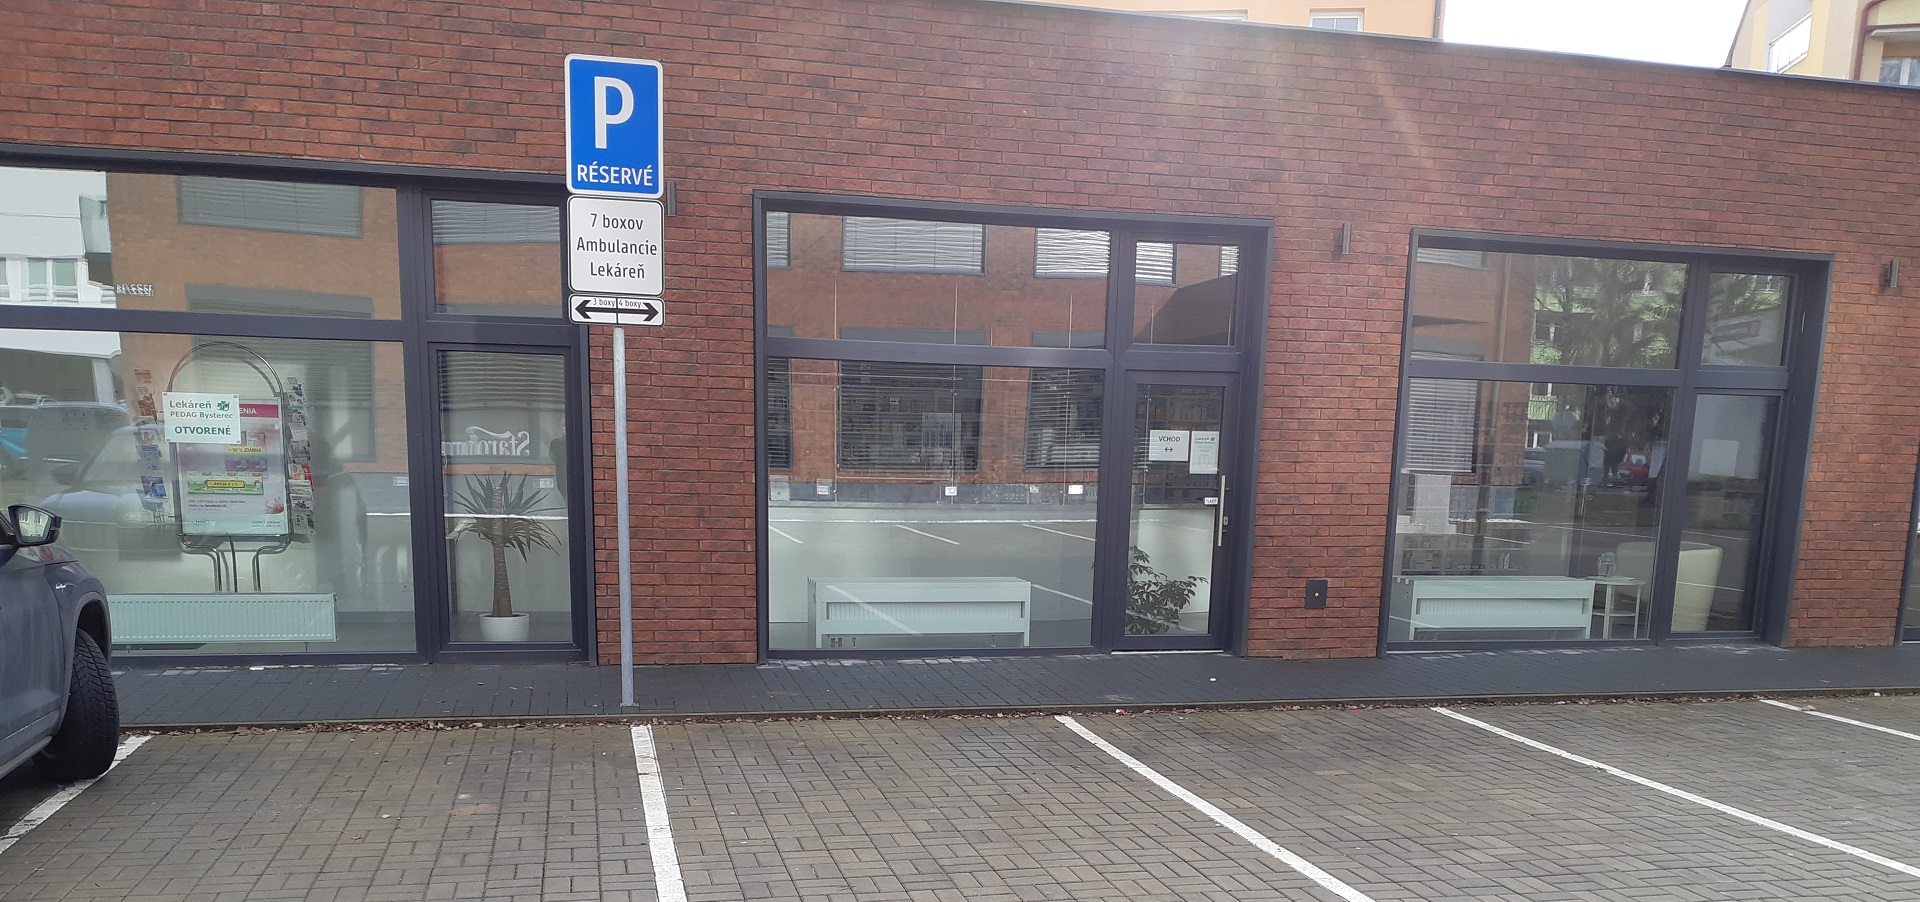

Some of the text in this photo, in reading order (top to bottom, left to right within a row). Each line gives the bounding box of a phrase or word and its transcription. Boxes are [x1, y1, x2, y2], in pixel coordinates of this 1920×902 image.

[594, 76, 634, 149] P
[577, 161, 653, 187] RÉSERVÉ
[590, 213, 644, 231] 7 boxov
[576, 236, 657, 256] Ambulancie
[590, 261, 645, 279] Lekáreň
[593, 298, 616, 308] 3 boxy
[625, 300, 642, 309] boxy
[169, 400, 212, 409] Lekáreň
[199, 411, 234, 420] Bysterec
[239, 407, 257, 415] ENIA
[174, 425, 232, 435] OTVORENÉ
